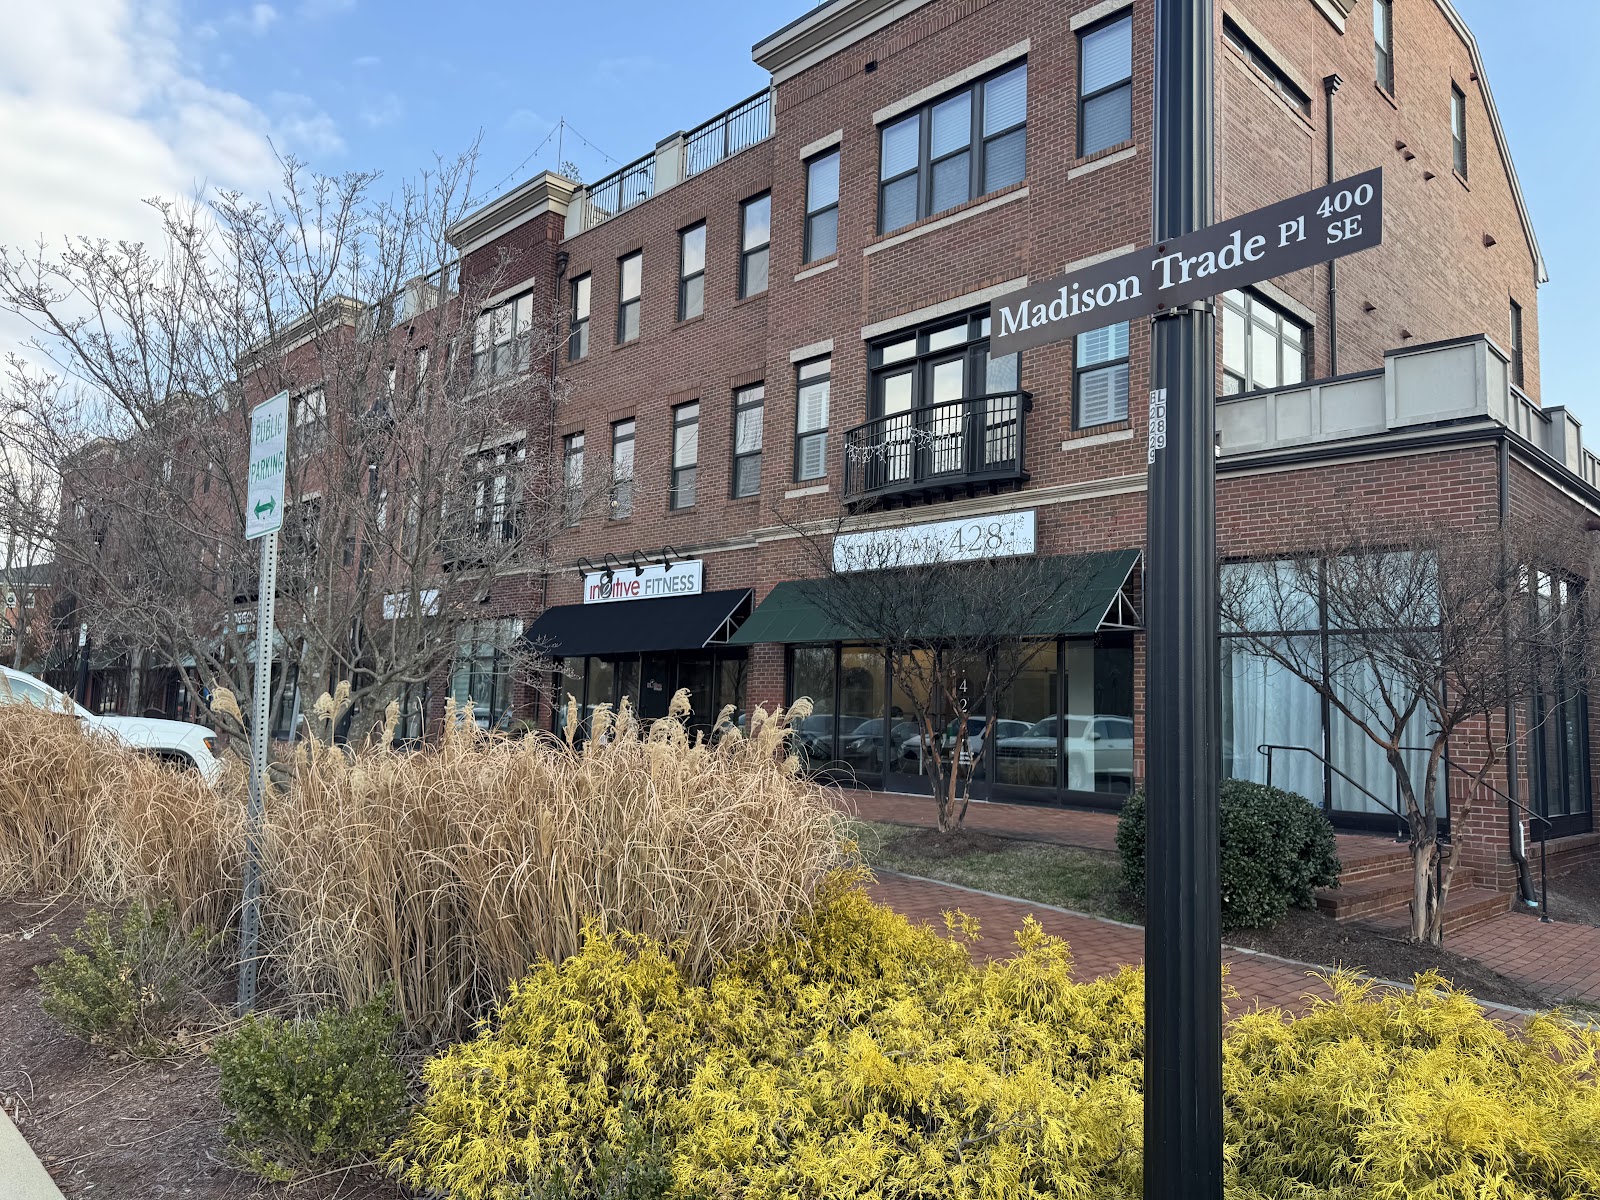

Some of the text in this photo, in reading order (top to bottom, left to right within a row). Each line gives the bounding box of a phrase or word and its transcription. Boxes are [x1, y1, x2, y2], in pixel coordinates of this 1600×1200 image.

[1316, 183, 1374, 219] 400
[1326, 214, 1364, 245] SE
[997, 215, 1307, 338] Madison Trade Pl
[255, 412, 283, 445] PUBLIC
[250, 450, 284, 485] PARKING
[950, 522, 1003, 552] 428
[645, 574, 695, 595] FITNESS
